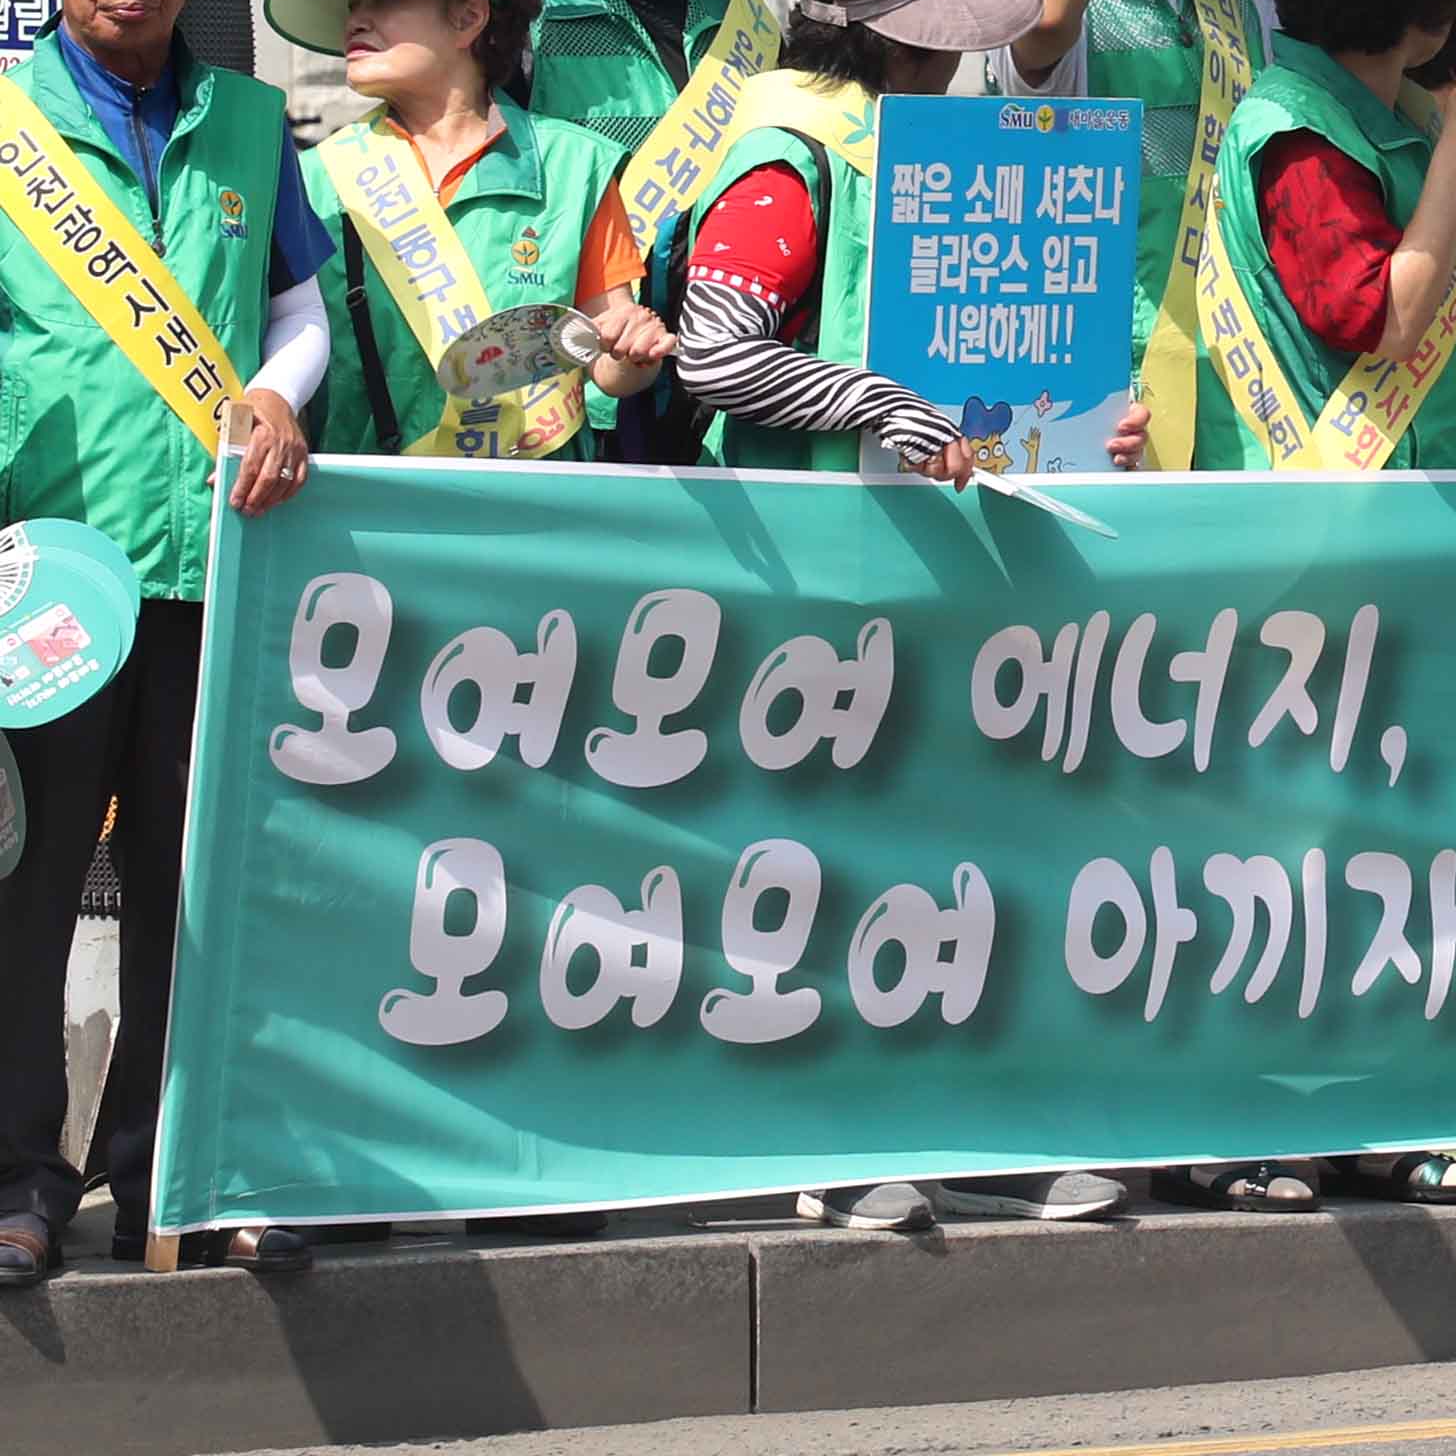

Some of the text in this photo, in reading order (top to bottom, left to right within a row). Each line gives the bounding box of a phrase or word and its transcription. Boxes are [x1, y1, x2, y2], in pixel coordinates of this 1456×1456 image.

[999, 104, 1130, 133] SMU 새마을운동
[355, 155, 416, 229] 인천
[891, 162, 1126, 225] 짧은 소매 셔츠나
[0, 130, 231, 432] 인천광역시새마
[507, 270, 545, 286] SMU
[909, 232, 1100, 296] 블라우스 입고
[927, 303, 1076, 366] 시원하게!!
[269, 572, 1409, 788] 오여오여 에너지,
[378, 837, 996, 1045] 오여오여
